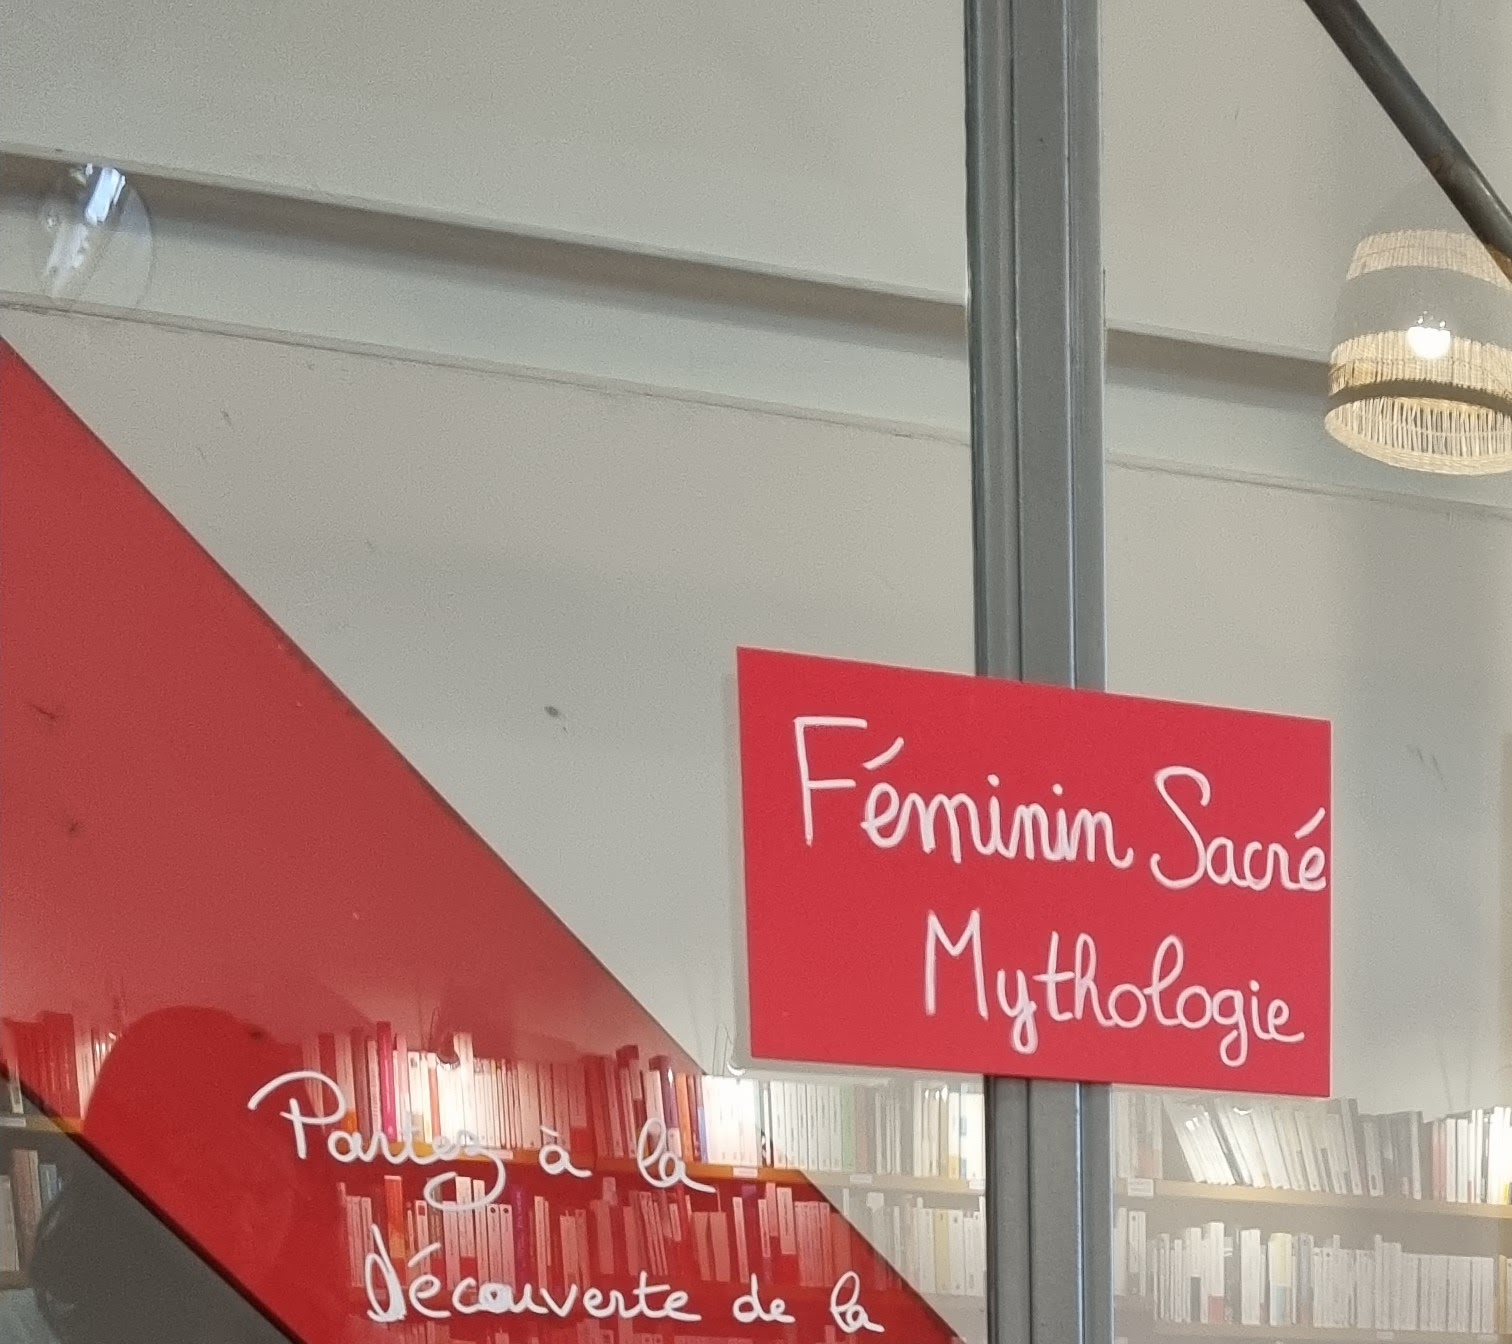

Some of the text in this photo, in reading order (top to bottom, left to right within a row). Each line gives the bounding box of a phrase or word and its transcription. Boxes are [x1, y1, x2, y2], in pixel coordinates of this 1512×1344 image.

[793, 716, 1327, 890] Féminin Sacré
[925, 909, 1304, 1067] Mythologie
[248, 1070, 716, 1211] Partez à la
[363, 1224, 884, 1334] Découverte de la
